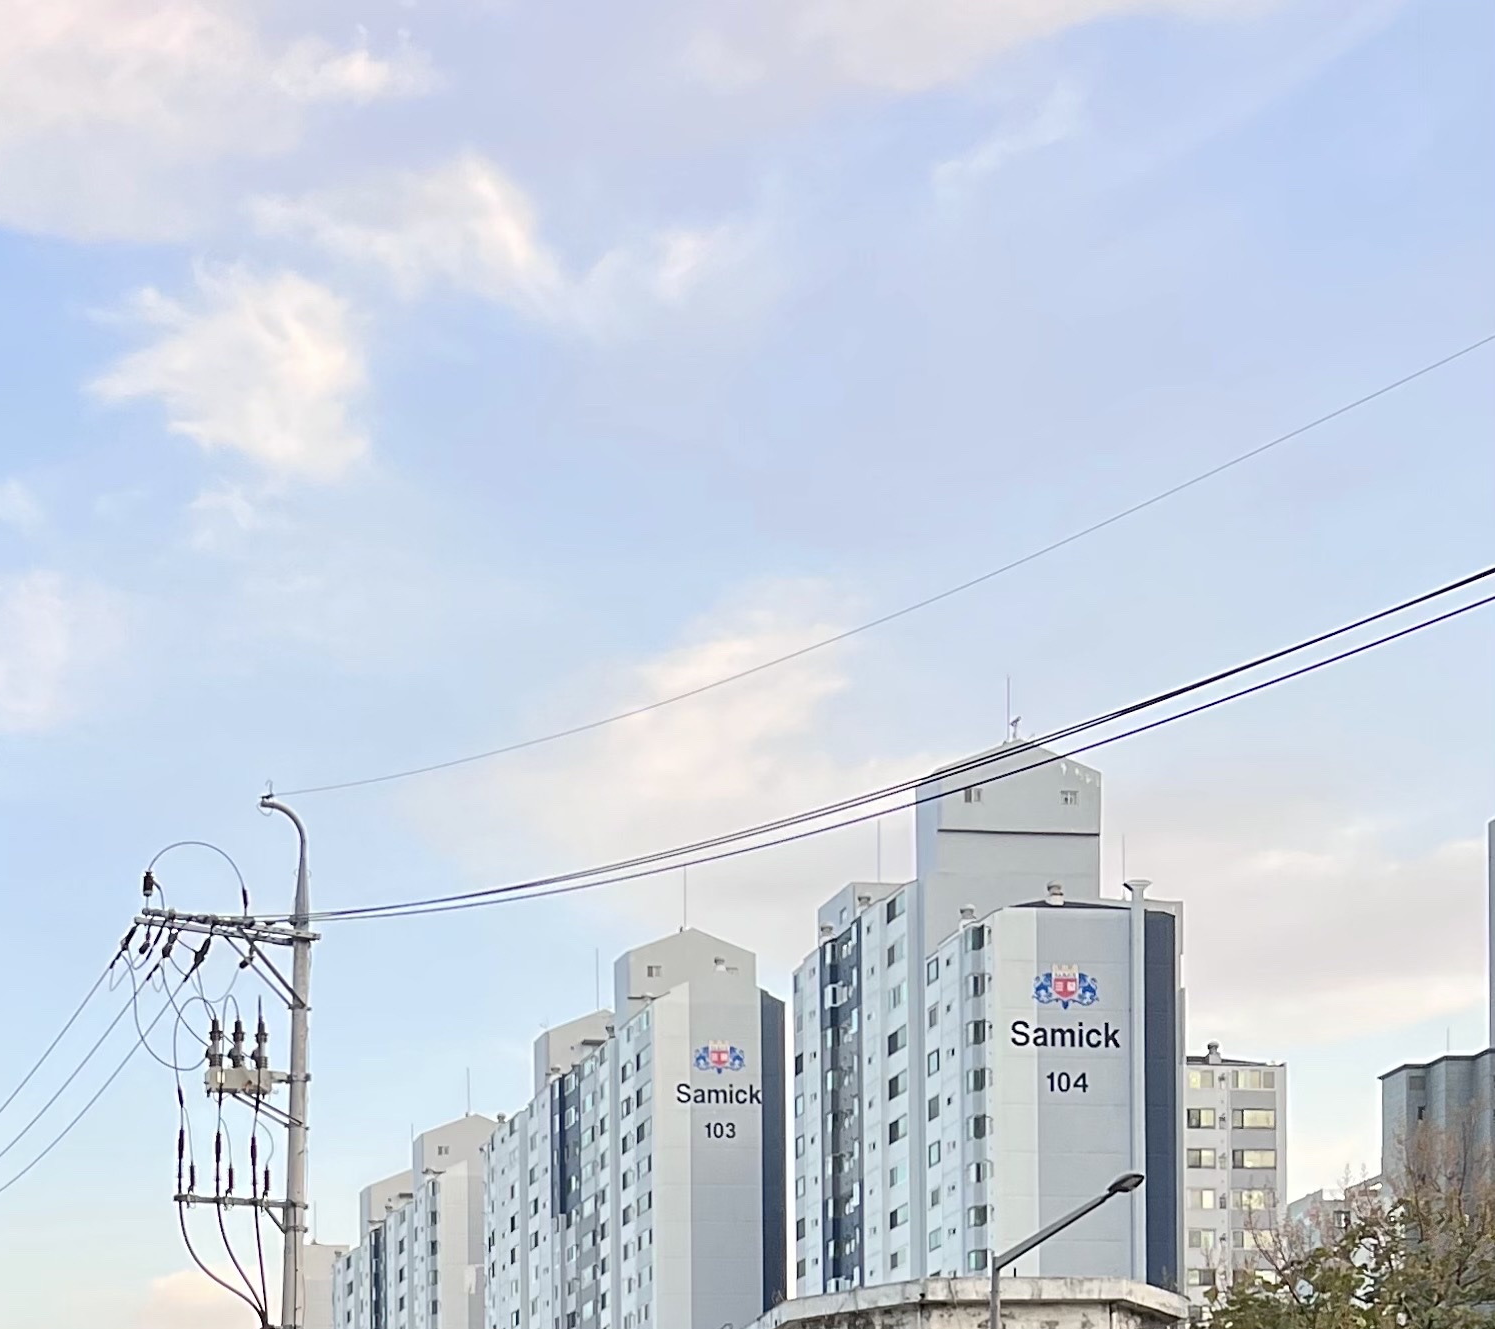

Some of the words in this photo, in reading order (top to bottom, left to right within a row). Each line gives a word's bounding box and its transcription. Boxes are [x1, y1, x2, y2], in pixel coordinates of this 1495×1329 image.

[1011, 1021, 1121, 1048] Samick
[1046, 1072, 1089, 1093] 104
[676, 1083, 762, 1105] Samick
[705, 1123, 736, 1139] 103
